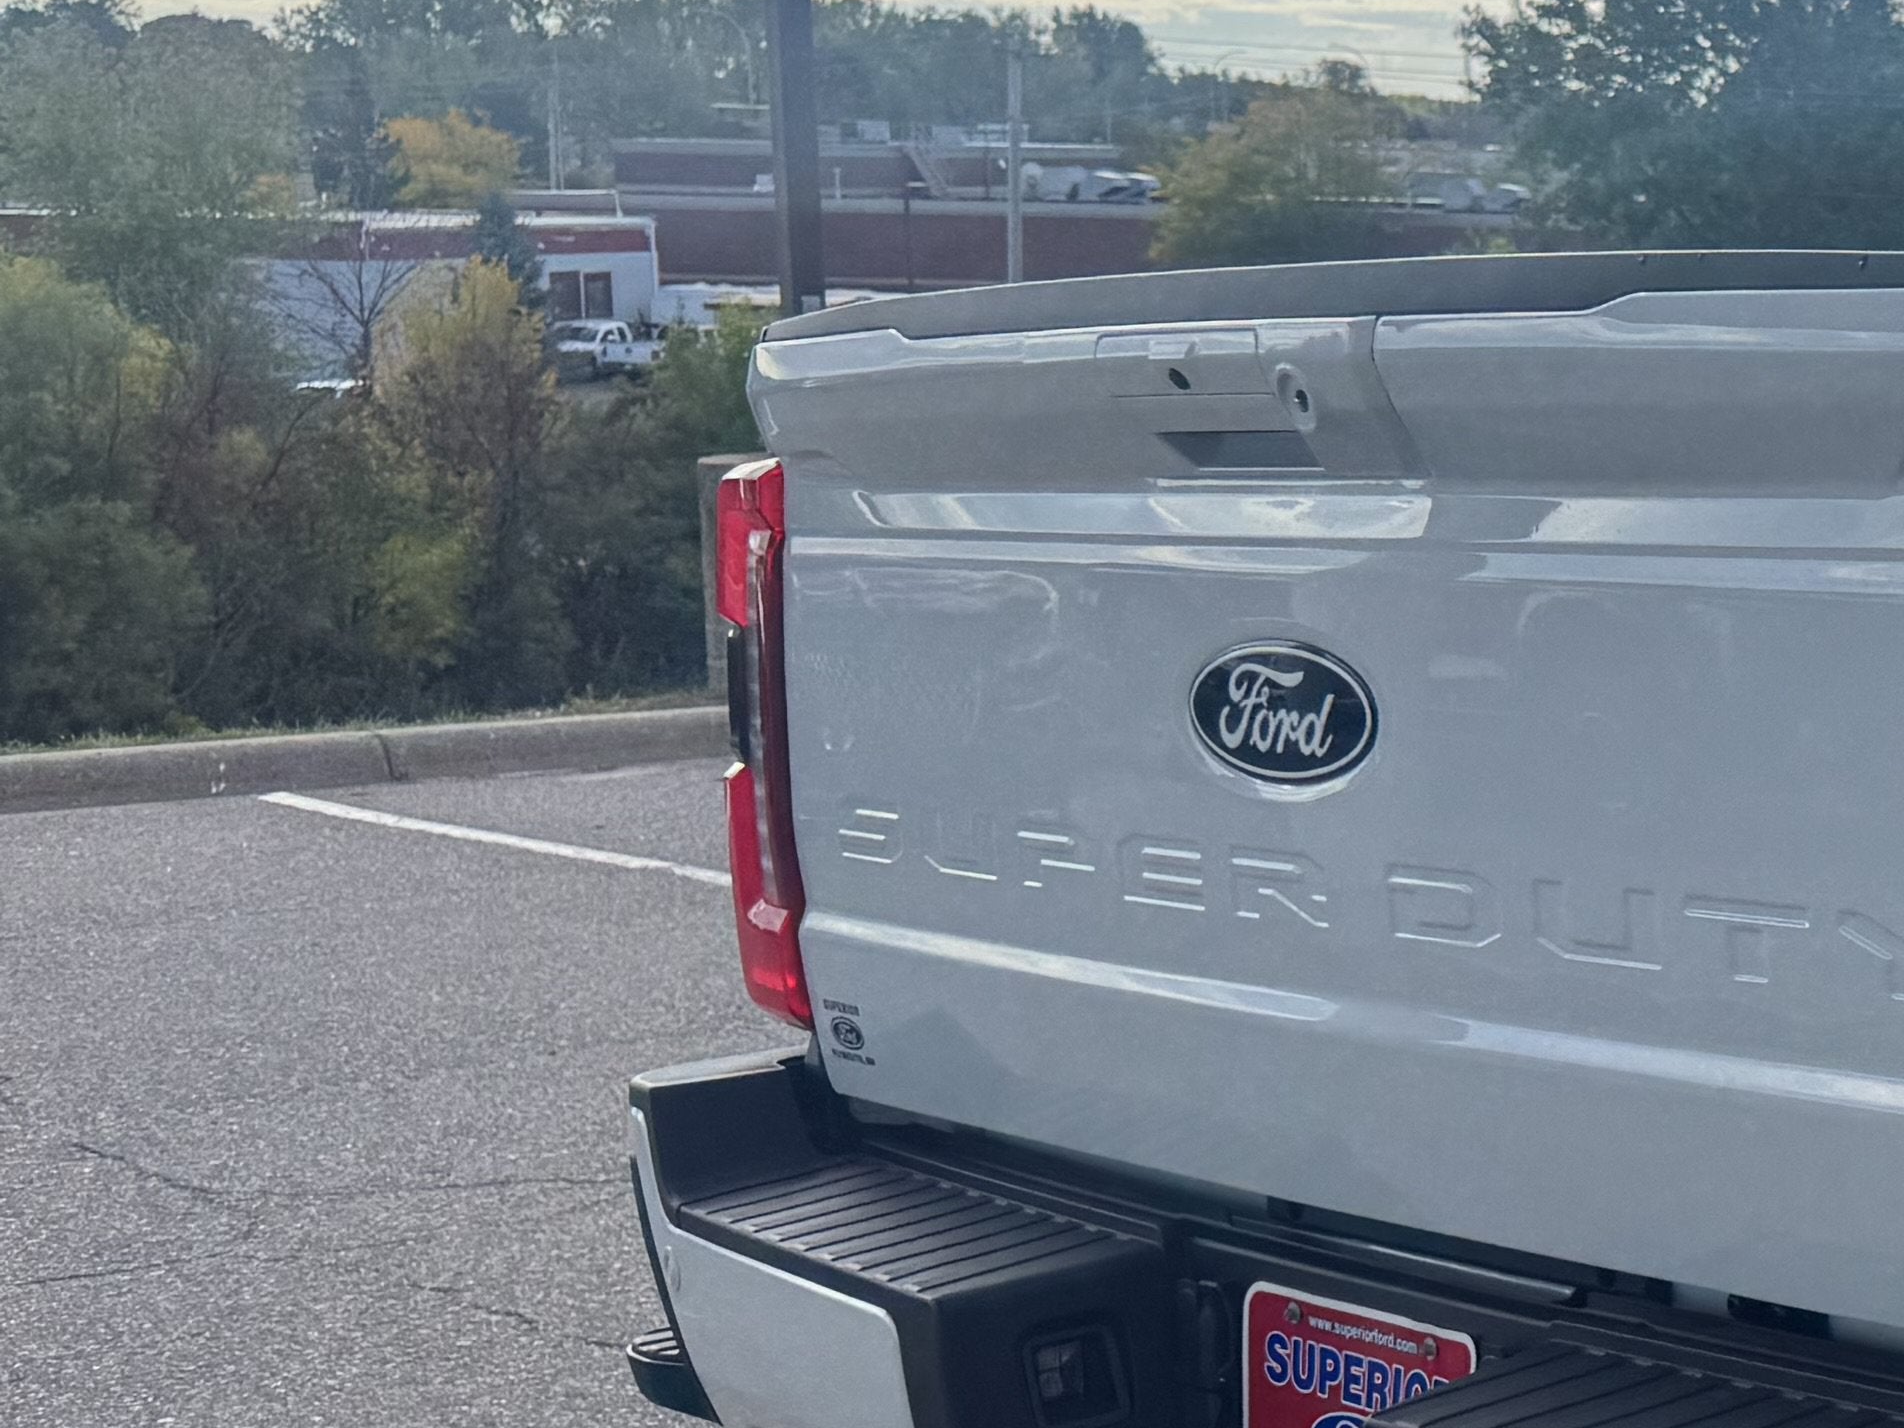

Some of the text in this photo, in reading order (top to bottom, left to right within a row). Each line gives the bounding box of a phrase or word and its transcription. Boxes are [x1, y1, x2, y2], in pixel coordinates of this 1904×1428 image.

[1219, 662, 1335, 758] Ford
[838, 806, 1330, 929] SUPER
[1264, 1330, 1450, 1413] SUPERIO
[1308, 1316, 1418, 1355] www.superiorford.com
